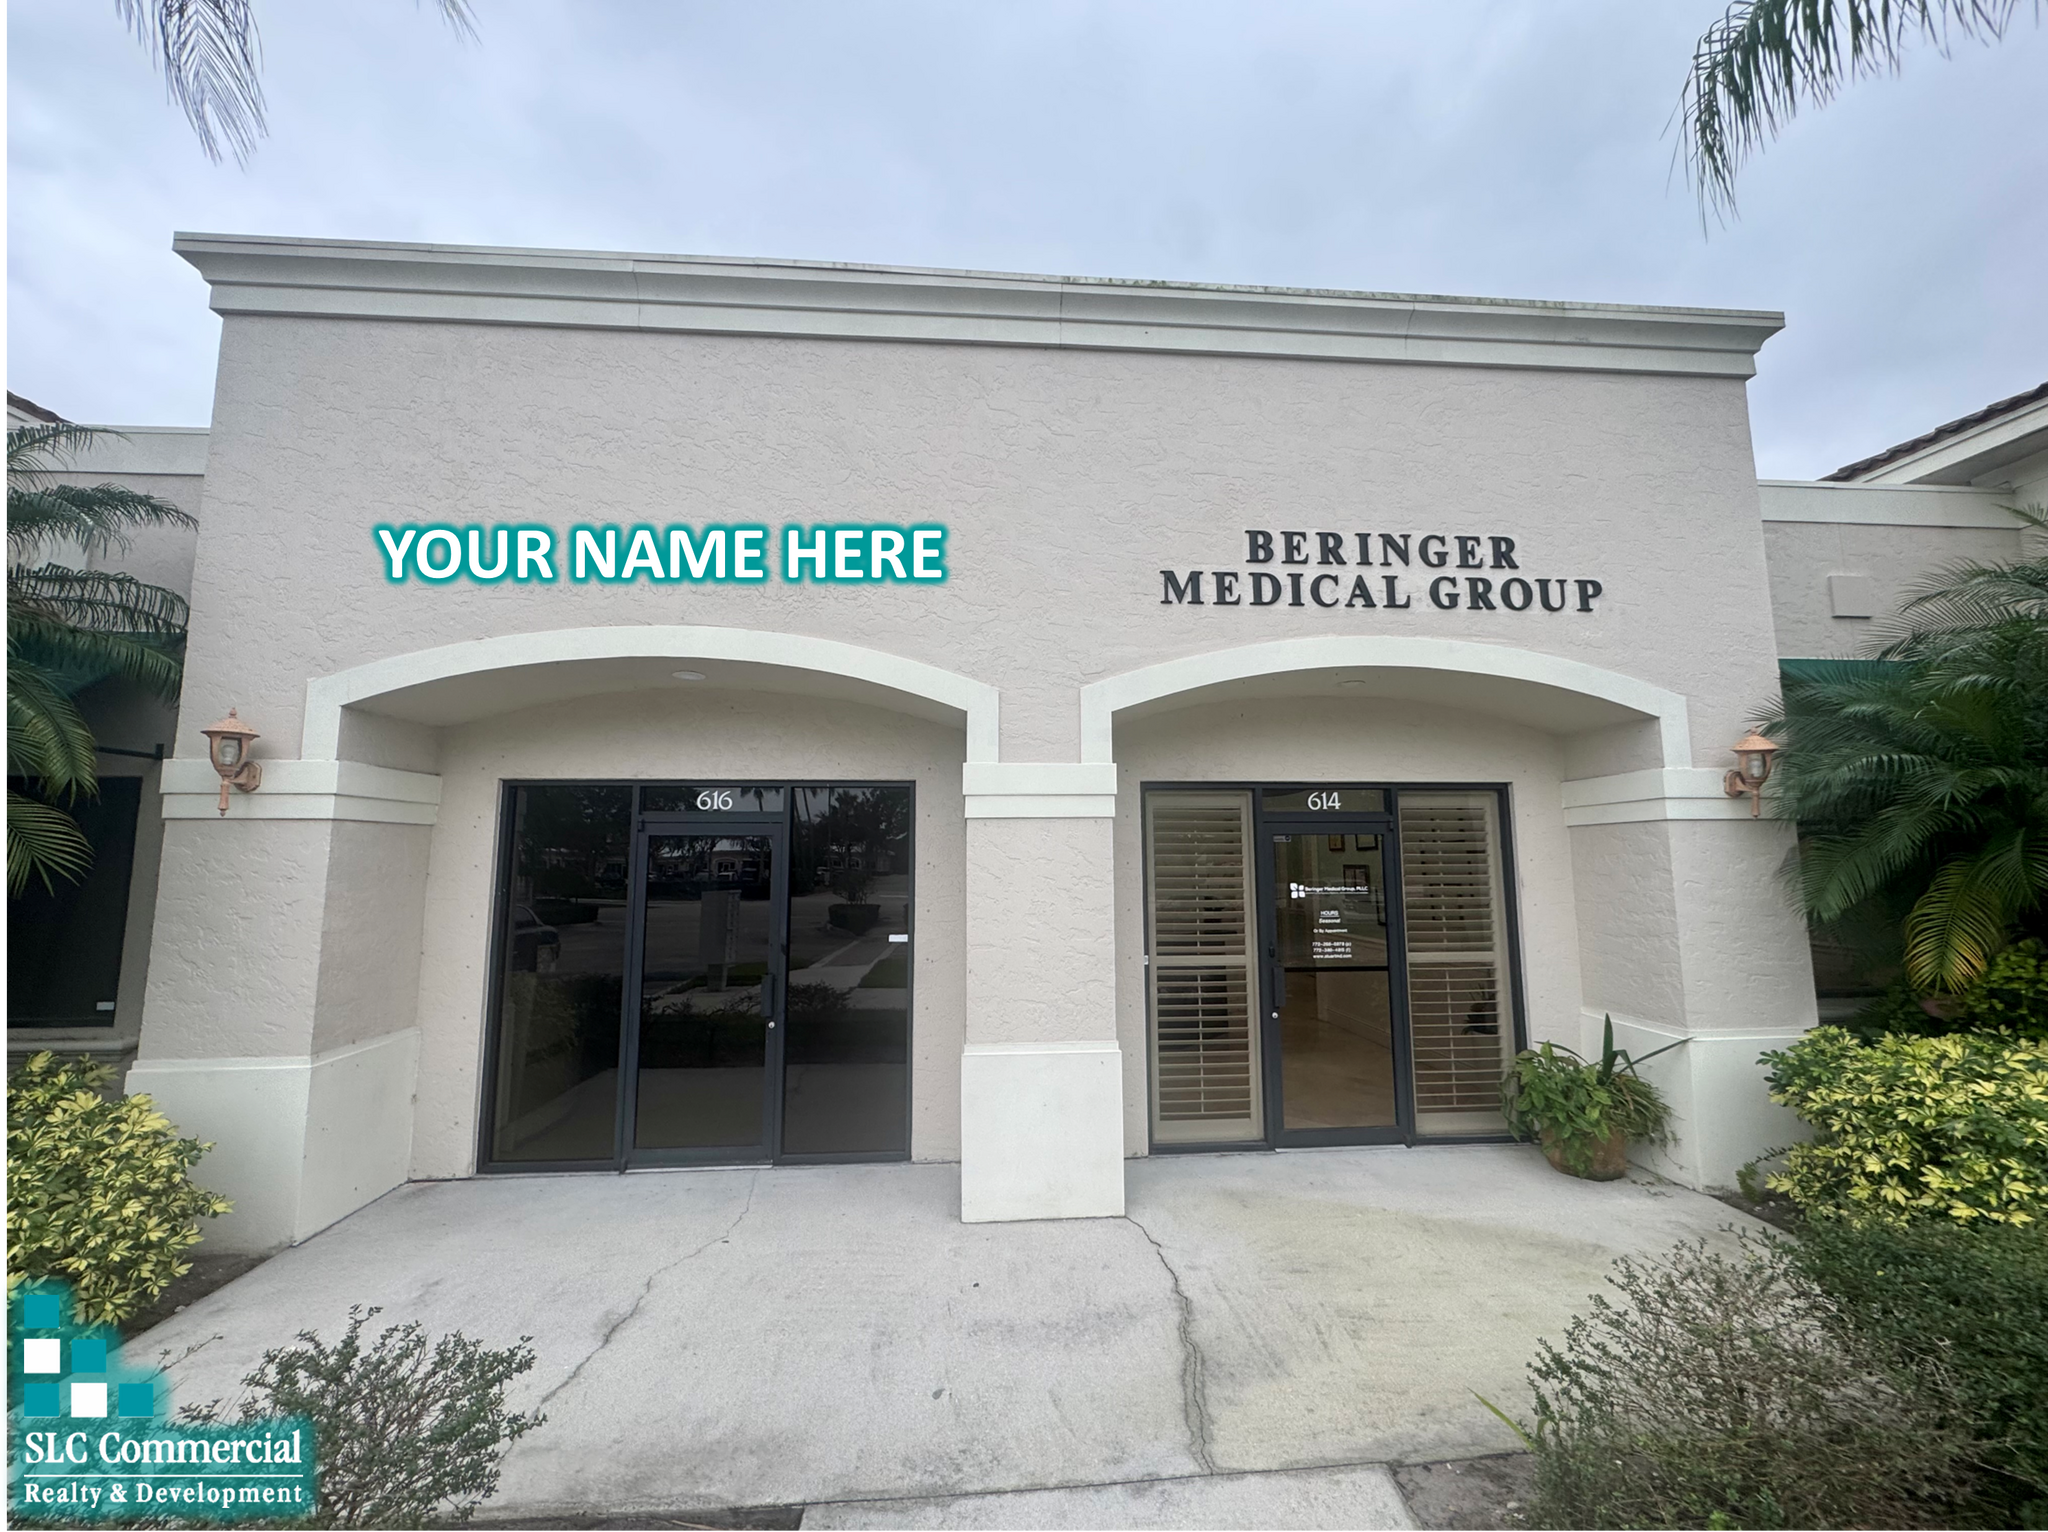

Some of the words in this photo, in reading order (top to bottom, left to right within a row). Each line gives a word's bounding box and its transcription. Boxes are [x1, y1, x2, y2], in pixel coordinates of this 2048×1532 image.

[1245, 529, 1519, 569] BERINGER
[1160, 570, 1411, 609] MEDICAL
[1429, 575, 1603, 612] GROUP
[696, 790, 733, 811] 616
[1307, 791, 1342, 811] 614
